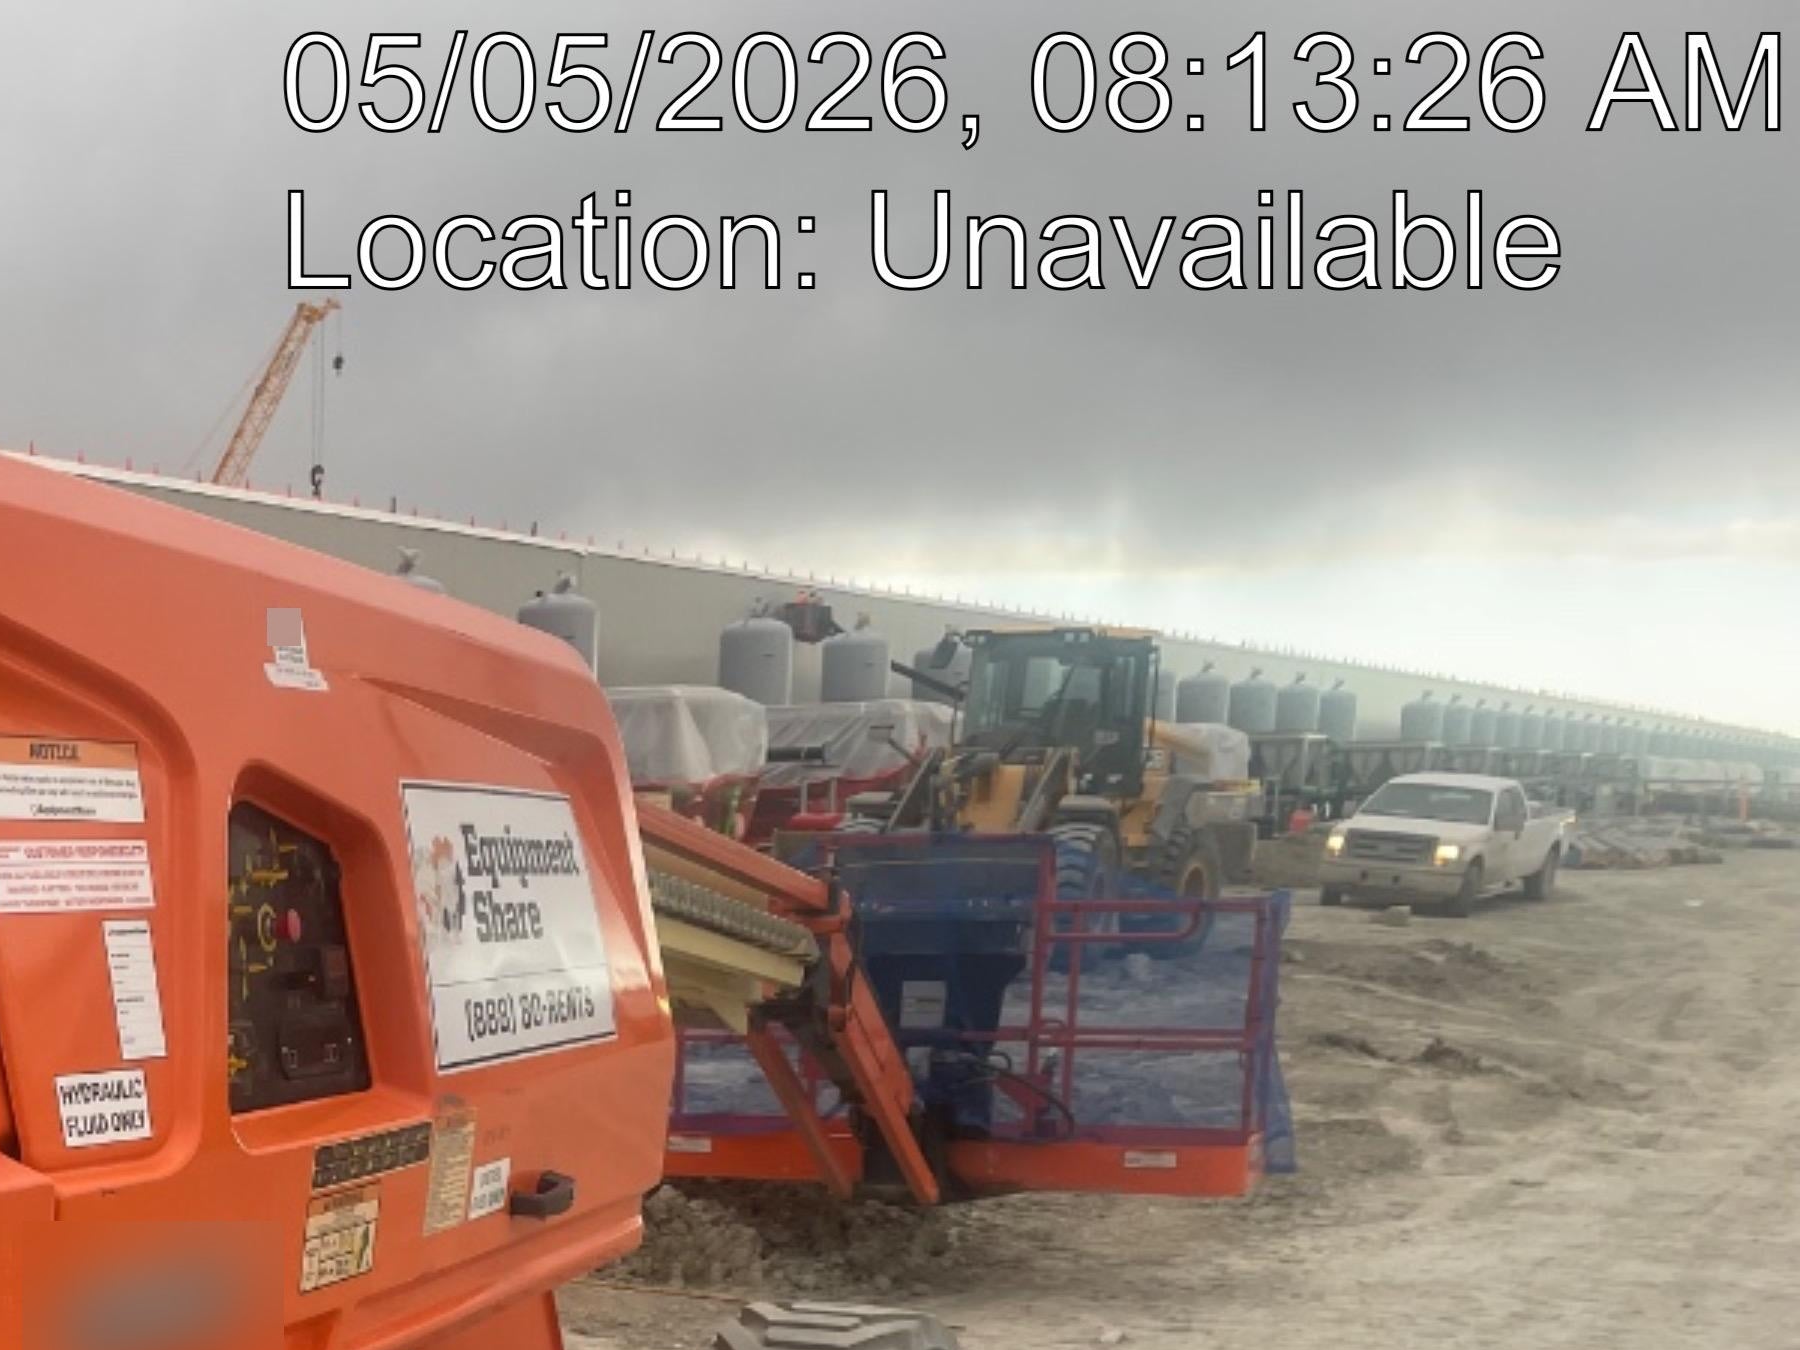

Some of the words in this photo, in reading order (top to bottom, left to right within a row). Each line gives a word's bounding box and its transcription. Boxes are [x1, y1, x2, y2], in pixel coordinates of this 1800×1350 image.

[459, 823, 580, 889] Equipment
[473, 889, 544, 943] Share
[464, 992, 517, 1043] (888)
[60, 1077, 143, 1105] HYDRAULIC
[66, 1112, 109, 1138] FLUID
[111, 1108, 145, 1133] ONLY
